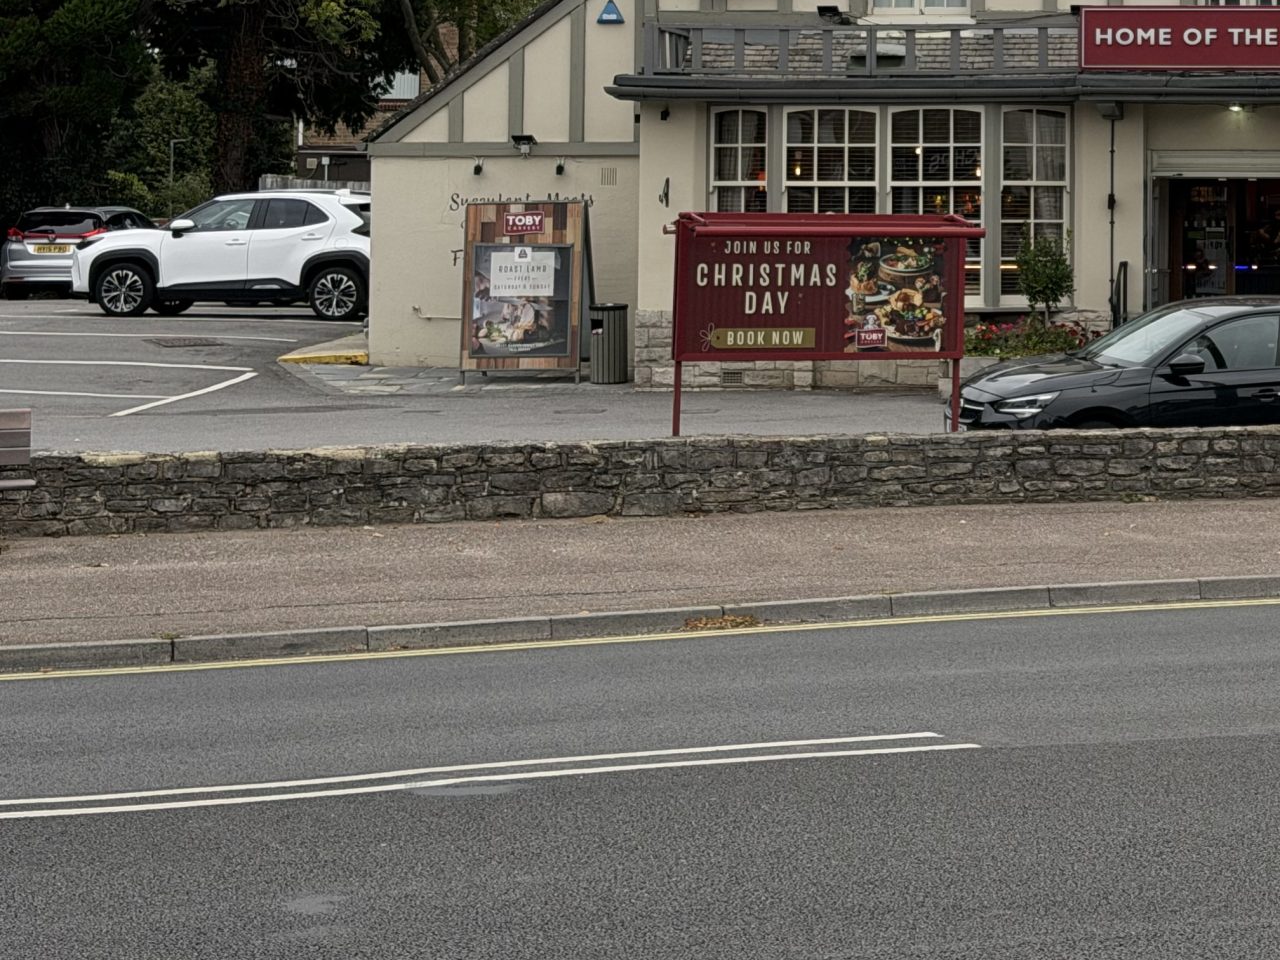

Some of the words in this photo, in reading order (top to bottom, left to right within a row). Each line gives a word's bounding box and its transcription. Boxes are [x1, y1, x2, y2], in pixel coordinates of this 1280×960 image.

[1095, 28, 1172, 46] HOME
[1183, 28, 1218, 46] OF
[1228, 28, 1278, 46] THE
[506, 215, 542, 225] TOBY
[724, 241, 757, 254] JOIN
[764, 241, 780, 254] US
[786, 241, 811, 254] FOR
[498, 265, 522, 273] ROAST
[696, 263, 837, 286] CHRISTMAS
[744, 291, 789, 314] DAY
[727, 331, 765, 345] BOOK
[772, 331, 804, 345] NOW
